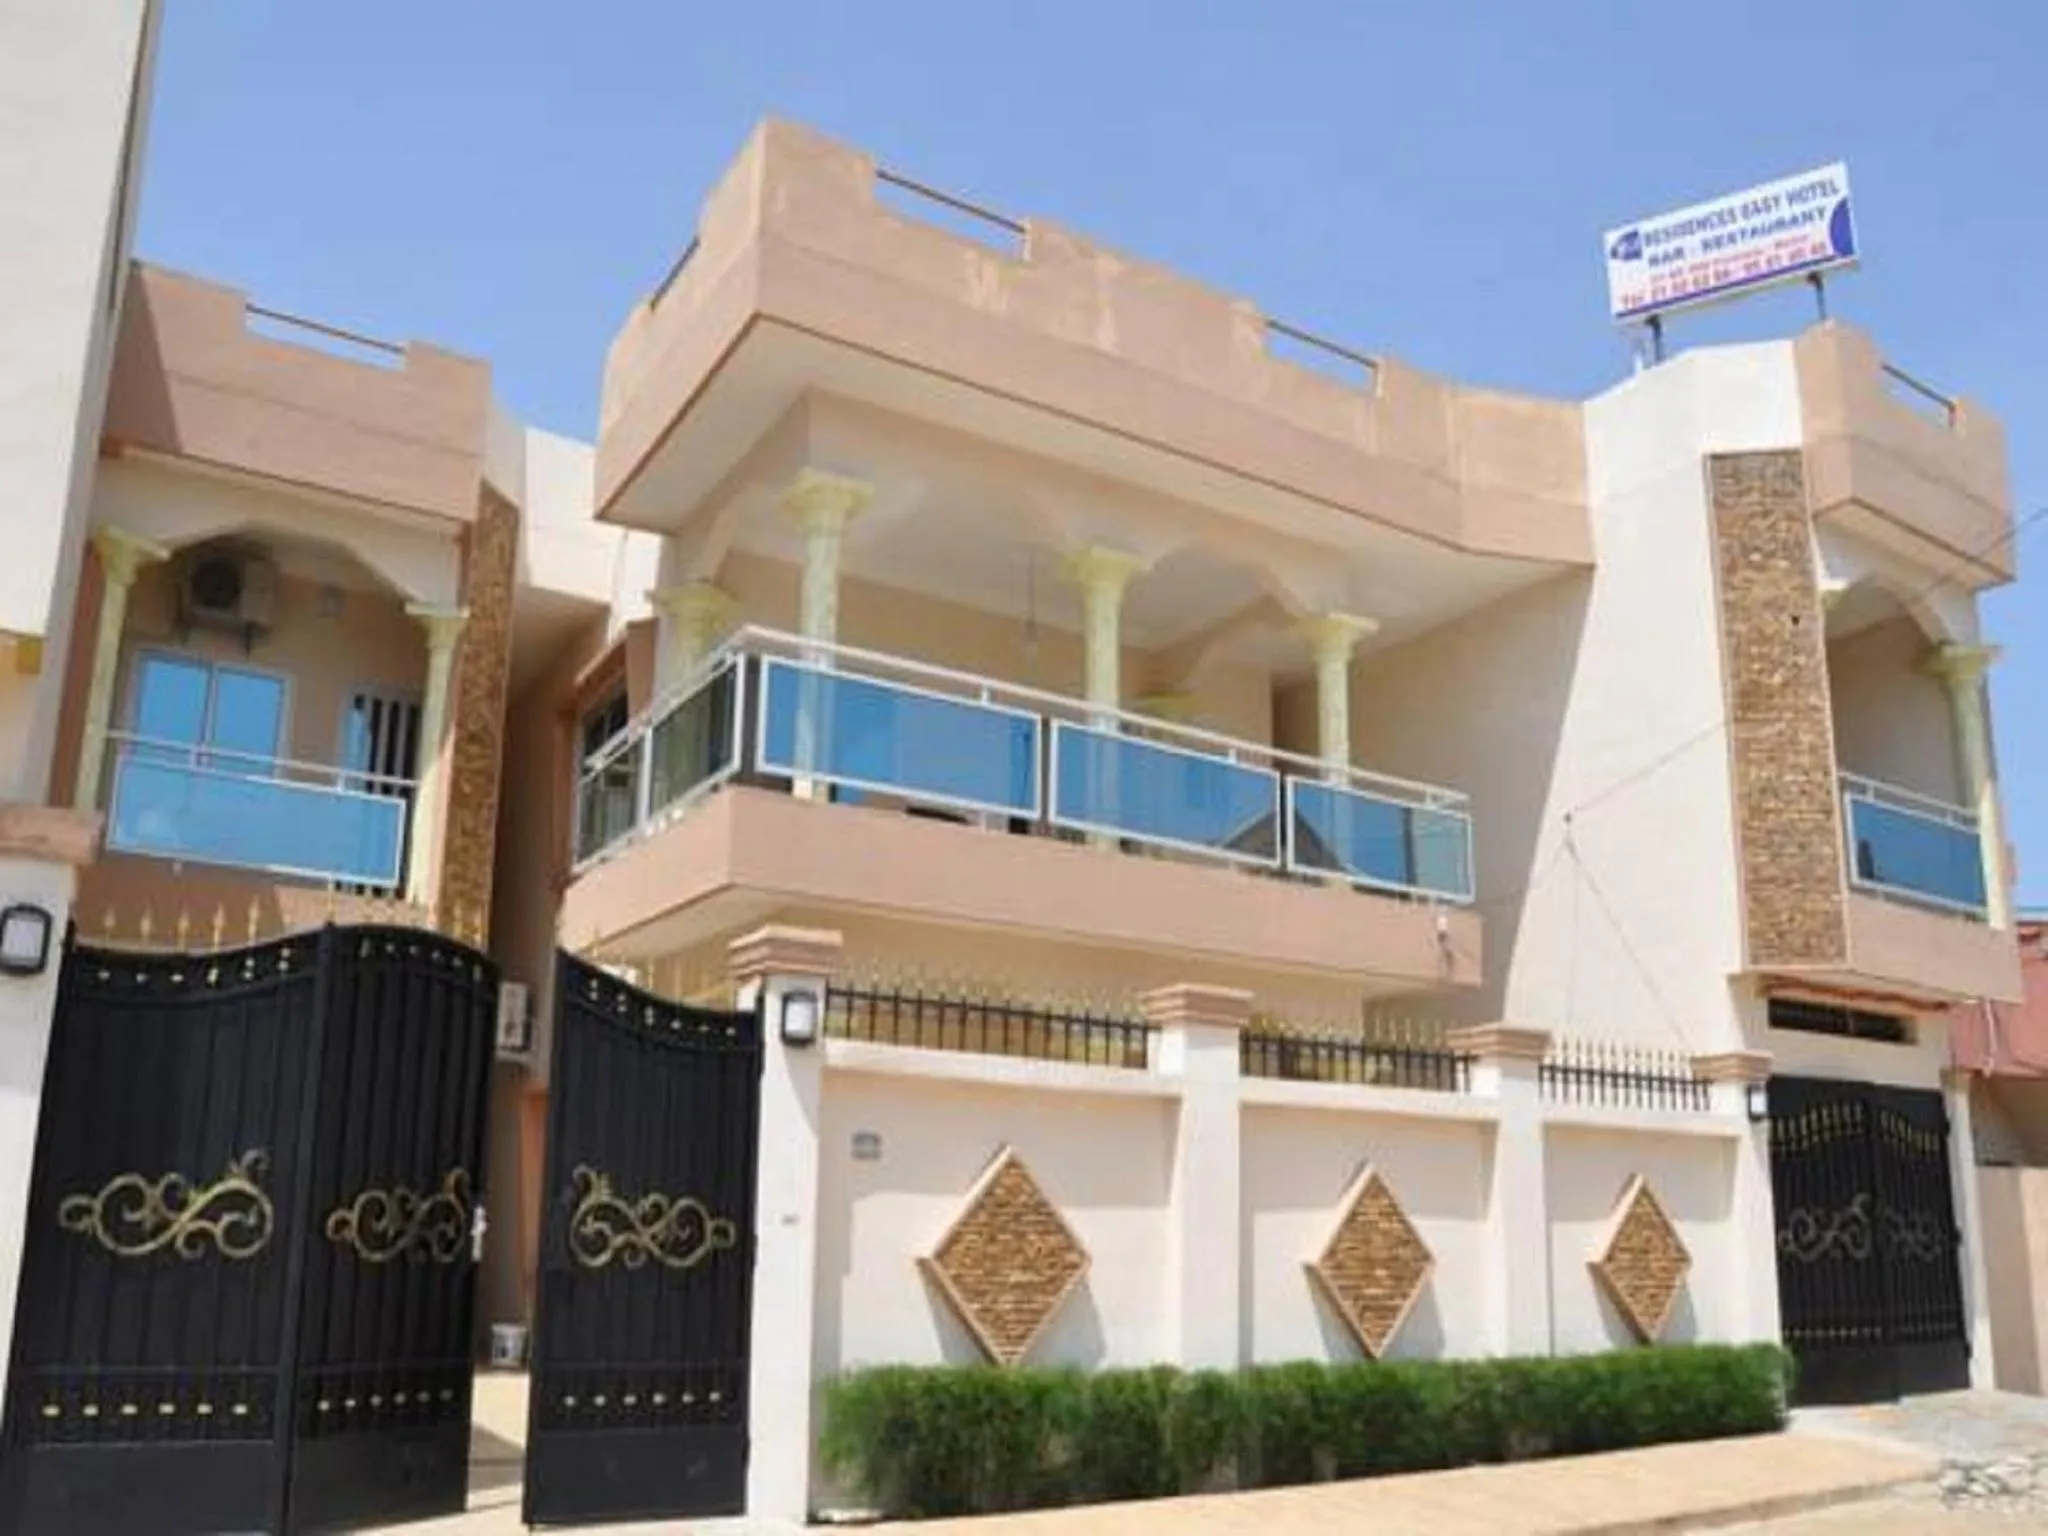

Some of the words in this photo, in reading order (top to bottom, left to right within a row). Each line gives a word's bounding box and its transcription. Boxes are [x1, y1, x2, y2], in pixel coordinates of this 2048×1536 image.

[1740, 194, 1781, 221] EAST
[1785, 178, 1840, 209] HOTEL
[1647, 246, 1685, 268] BAR
